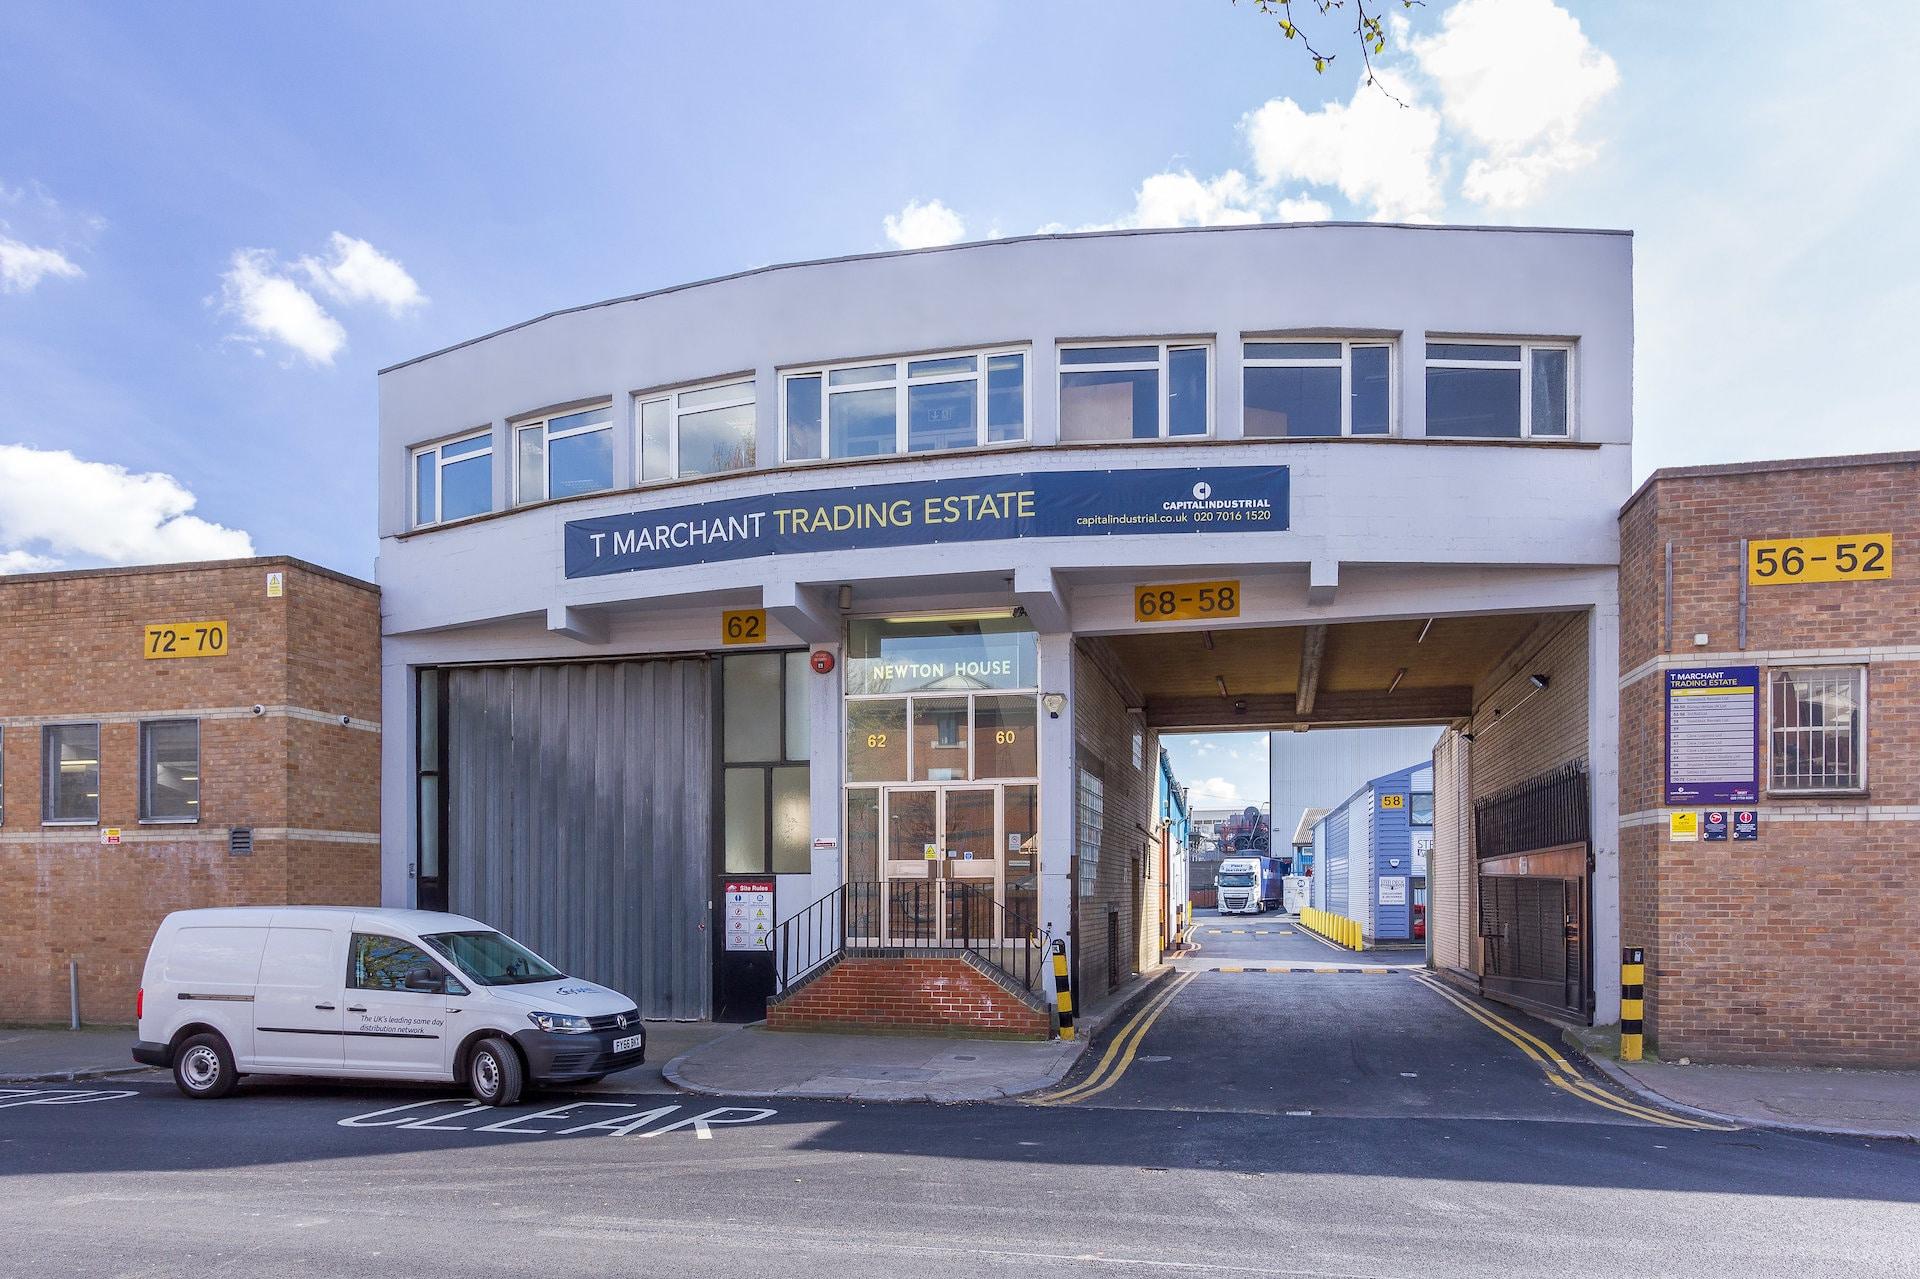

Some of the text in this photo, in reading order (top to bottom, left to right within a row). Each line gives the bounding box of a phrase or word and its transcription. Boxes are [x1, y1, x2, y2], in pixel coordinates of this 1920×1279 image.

[590, 490, 1036, 558] T MARCHANT TRADING ESTATE
[1076, 510, 1271, 527] capitalindustrial.co.uk 020 7016 1520
[728, 615, 759, 638] 62
[873, 660, 1011, 680] NEWTON HOUSE
[1677, 672, 1724, 680] MARCHANT
[867, 734, 887, 748] 62
[995, 730, 1016, 744] 60
[1384, 796, 1400, 806] 58
[373, 1015, 388, 1023] UK's
[388, 1016, 412, 1025] leading
[431, 1019, 444, 1027] day
[360, 1024, 424, 1034] distribution network
[337, 1098, 777, 1140] CLEAR
